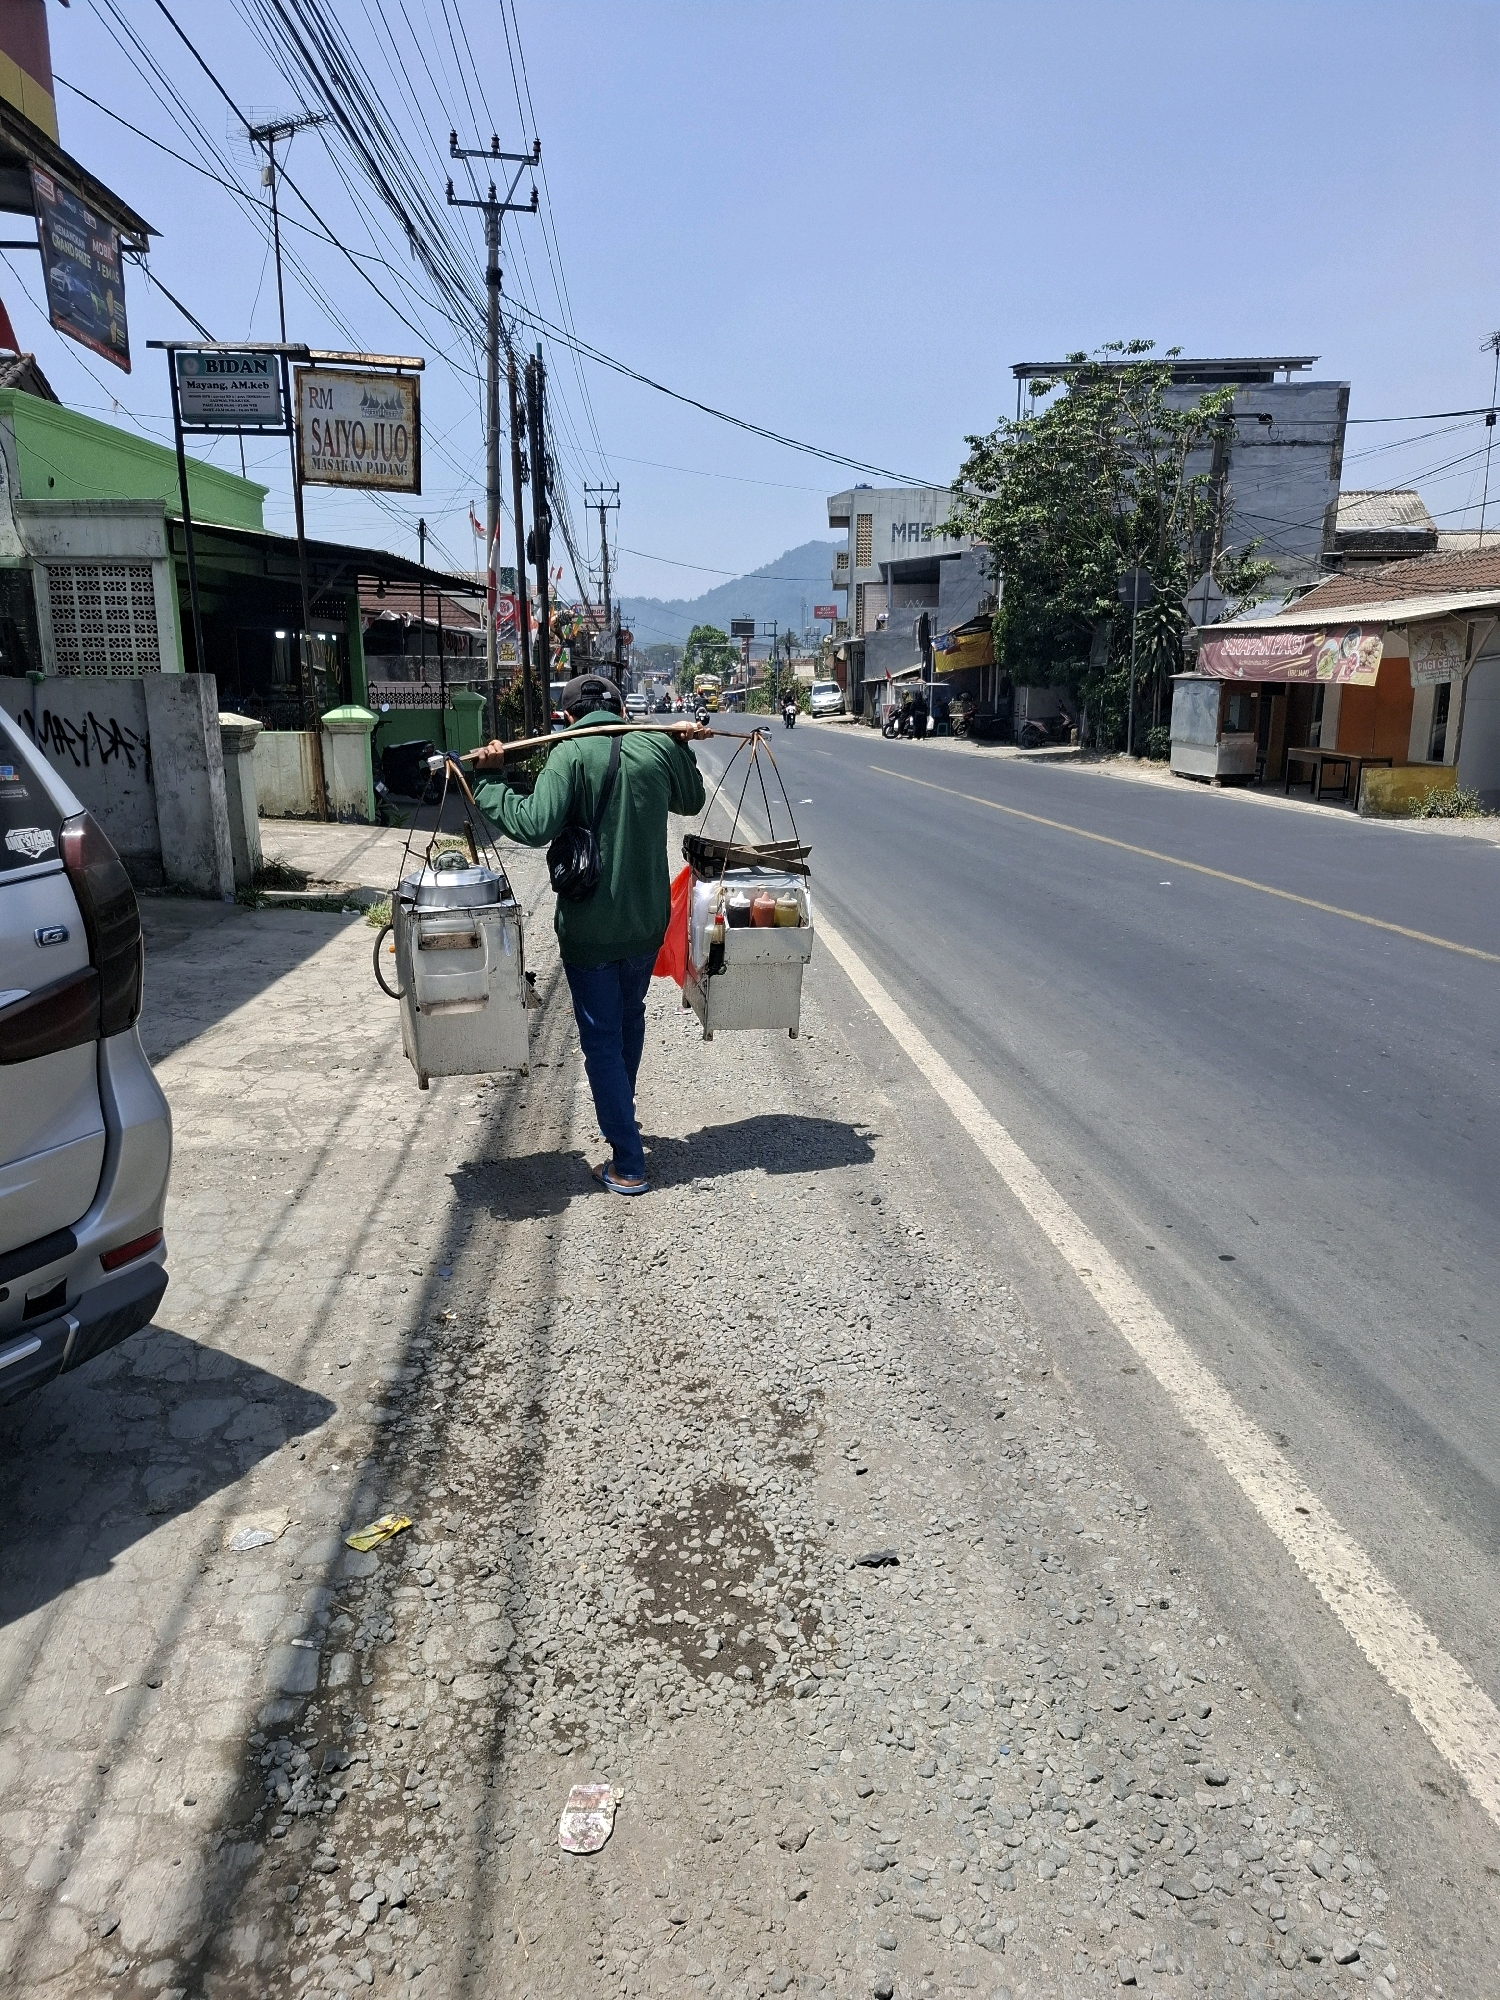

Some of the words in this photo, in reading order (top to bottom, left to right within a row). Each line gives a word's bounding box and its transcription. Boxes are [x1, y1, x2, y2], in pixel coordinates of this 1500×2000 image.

[52, 232, 75, 258] GRAND
[74, 247, 92, 269] PRIZE
[92, 238, 114, 261] MOBIL
[101, 261, 120, 285] EMAS
[204, 359, 268, 374] BIDAN
[186, 381, 228, 391] Mayang,
[231, 381, 270, 390] AM.keb
[308, 386, 334, 410] RM
[311, 417, 366, 460] SAIYO
[371, 422, 409, 463] JUO
[312, 457, 363, 473] MASAKAN
[366, 461, 408, 477] PADANG
[1417, 660, 1436, 672] PAGI
